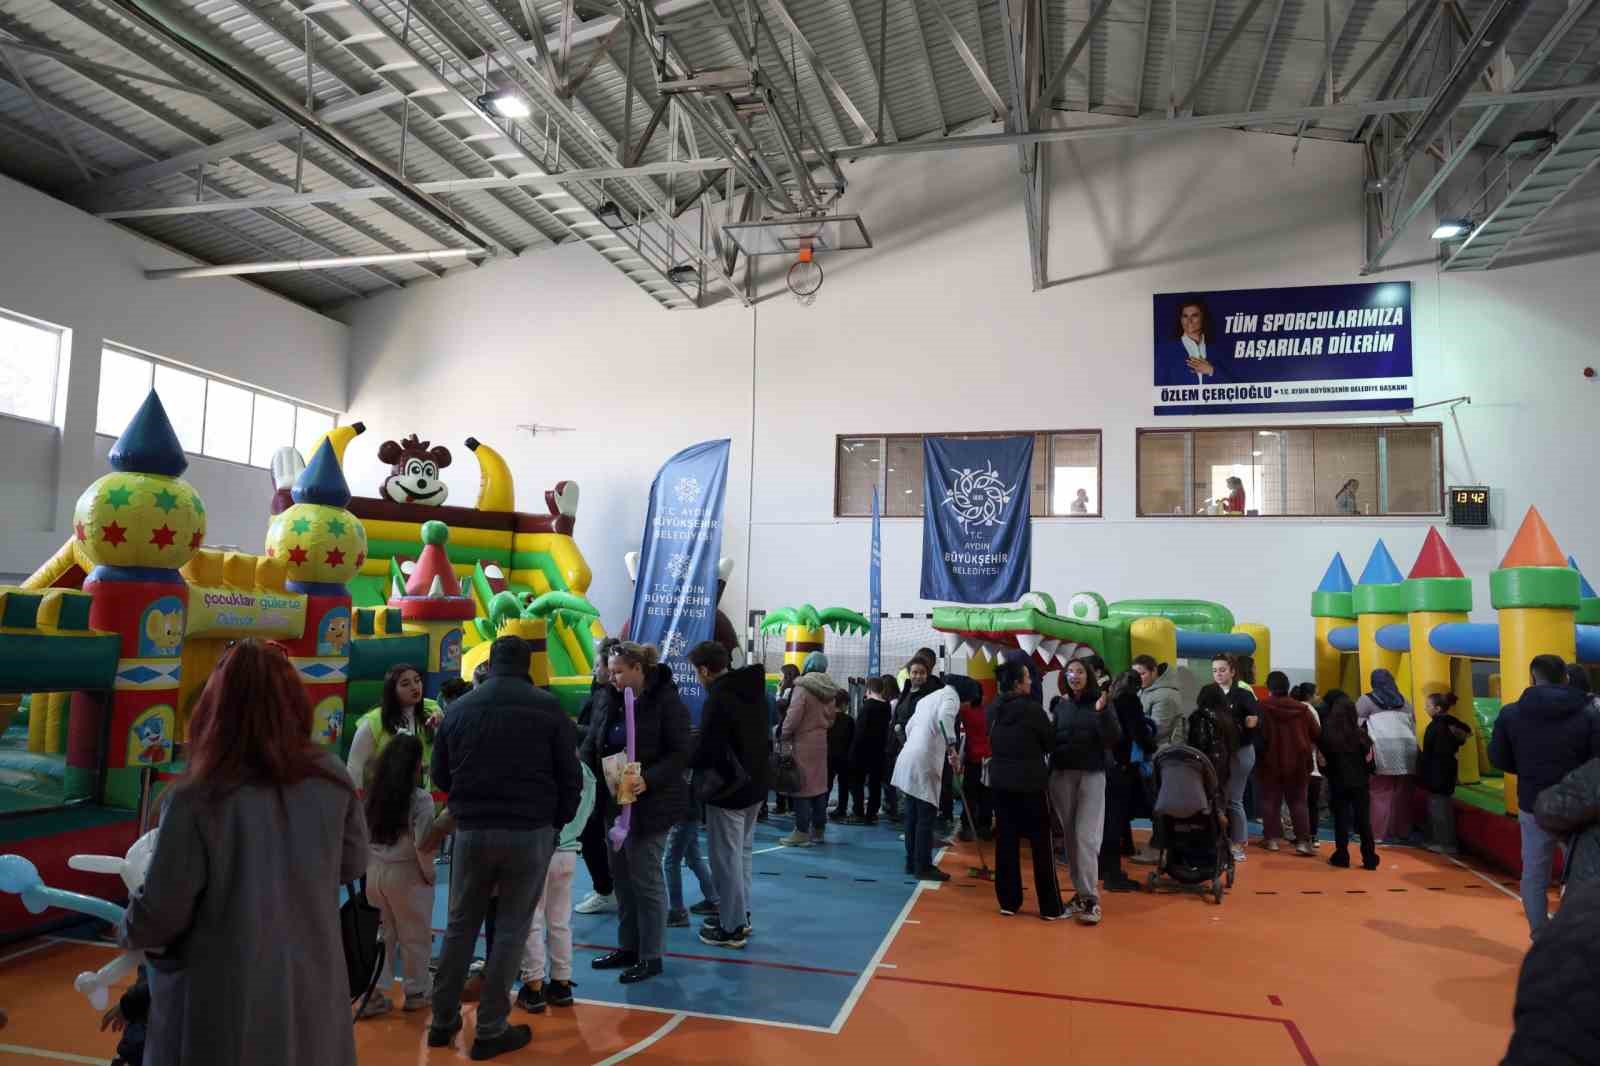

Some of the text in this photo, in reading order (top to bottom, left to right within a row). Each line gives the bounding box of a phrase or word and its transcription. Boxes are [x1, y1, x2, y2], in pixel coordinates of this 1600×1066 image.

[1225, 307, 1403, 333] TÜM SPORCULARIMIZA
[1234, 331, 1395, 360] BAŞARILAR DİLERİM
[1161, 388, 1199, 402] ÖZLEM
[1202, 385, 1272, 403] ÇERÇİOĞLU
[964, 542, 990, 551] AYDIN
[944, 551, 1008, 566] BÜYÜKŞEHİR
[952, 566, 1000, 576] BELEDİYESİ
